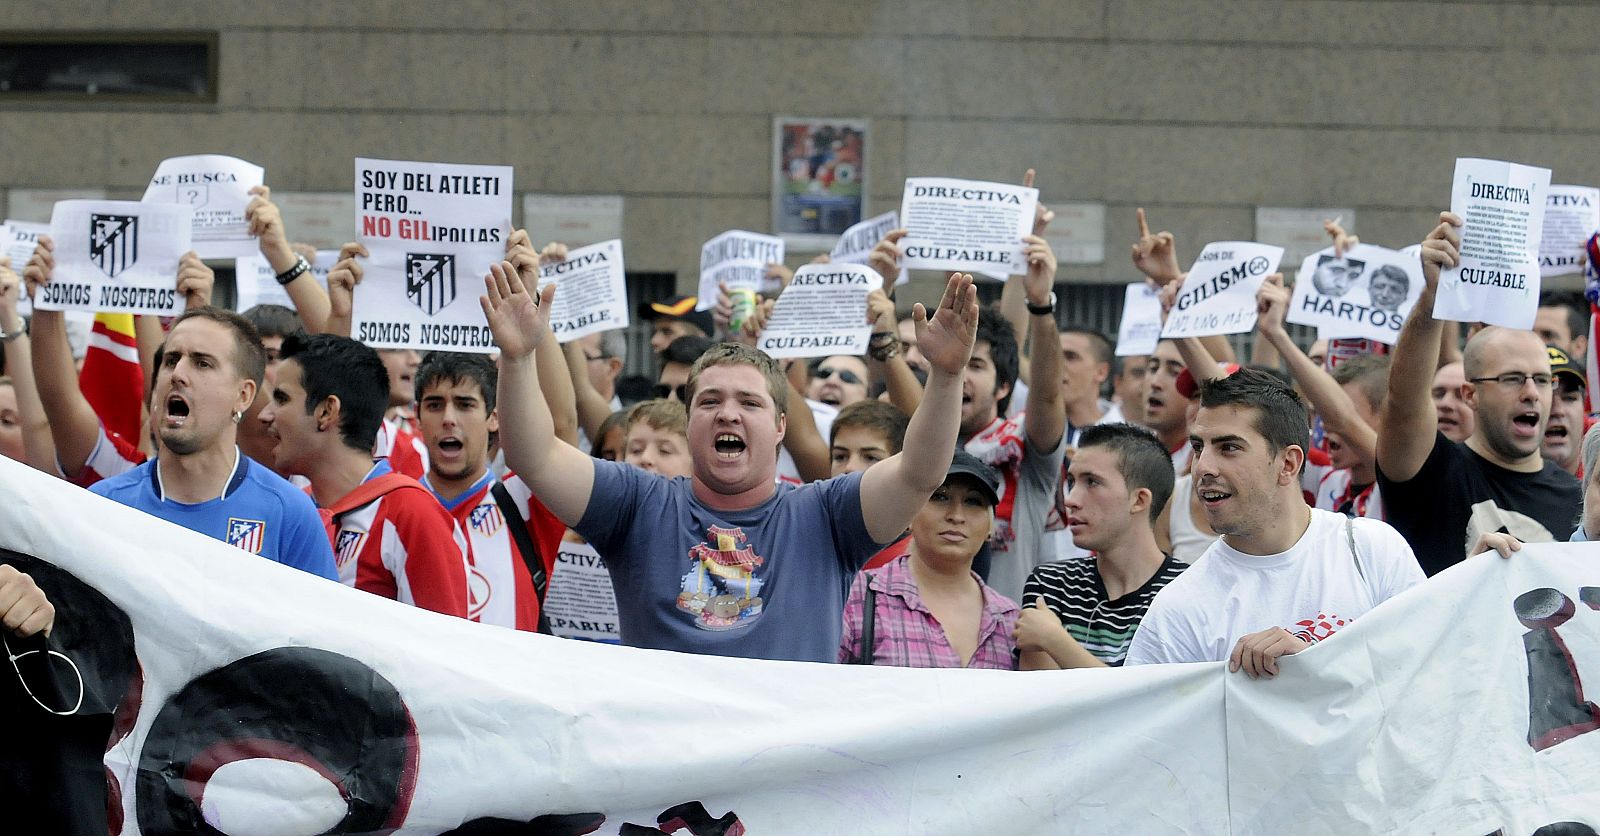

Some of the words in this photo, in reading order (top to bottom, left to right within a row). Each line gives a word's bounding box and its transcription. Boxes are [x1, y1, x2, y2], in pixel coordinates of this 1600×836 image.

[178, 171, 237, 184] BUSCA
[362, 170, 398, 191] SOY
[404, 173, 434, 193] DEL
[439, 175, 500, 196] ATLETI
[362, 193, 422, 216] PERO...
[913, 186, 1021, 205] DIRECTIVA
[1471, 183, 1530, 205] DIRECTIVA
[362, 215, 391, 239] NO
[905, 246, 1012, 264] CULPABLE
[1222, 250, 1235, 260] DE
[1460, 267, 1526, 290] CULPABLE
[43, 282, 91, 305] SOMOS
[101, 286, 175, 310] NOSOTROS
[550, 309, 612, 333] PABLE
[1303, 294, 1403, 332] HARTOS
[359, 322, 410, 344] SOMOS
[420, 324, 496, 348] NOSOTRO
[765, 335, 855, 350] CULPABLE
